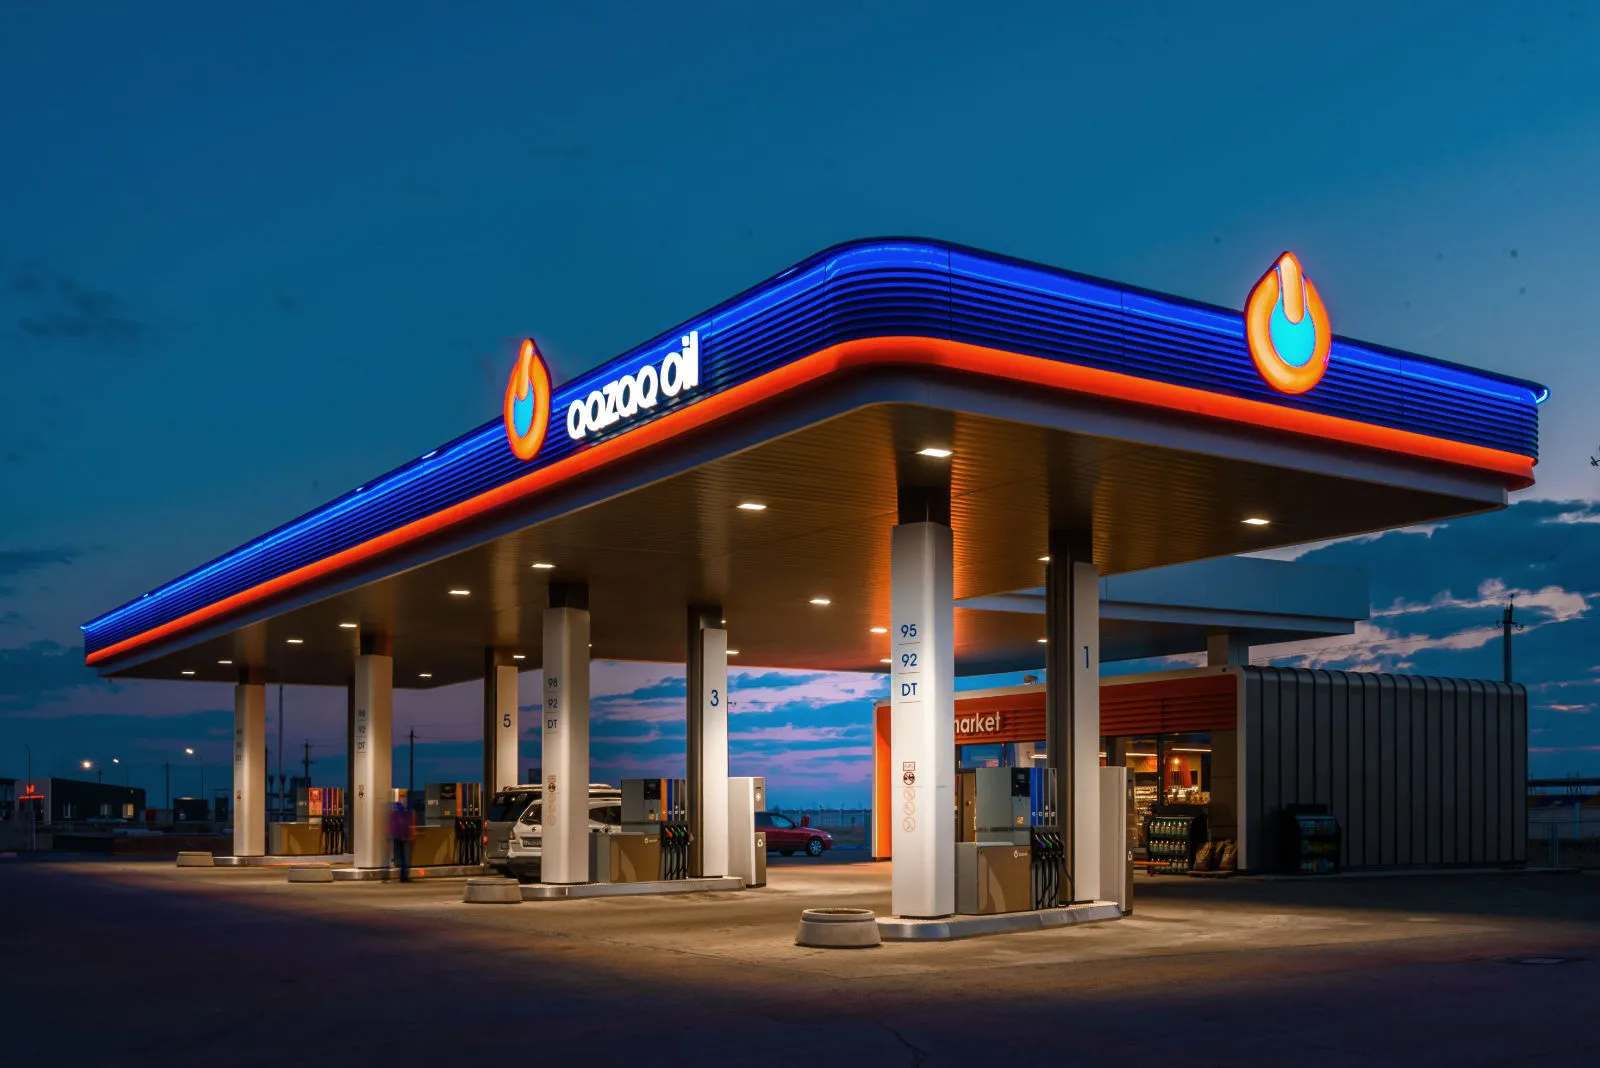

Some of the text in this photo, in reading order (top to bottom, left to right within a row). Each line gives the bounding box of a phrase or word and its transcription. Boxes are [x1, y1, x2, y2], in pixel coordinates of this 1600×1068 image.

[660, 331, 699, 396] oil
[900, 624, 917, 638] 95
[901, 653, 918, 667] 92
[1083, 646, 1089, 669] 1
[901, 683, 918, 697] DT
[547, 699, 558, 709] 92
[710, 689, 719, 707] 3
[503, 714, 511, 728] 5
[547, 719, 558, 729] DT
